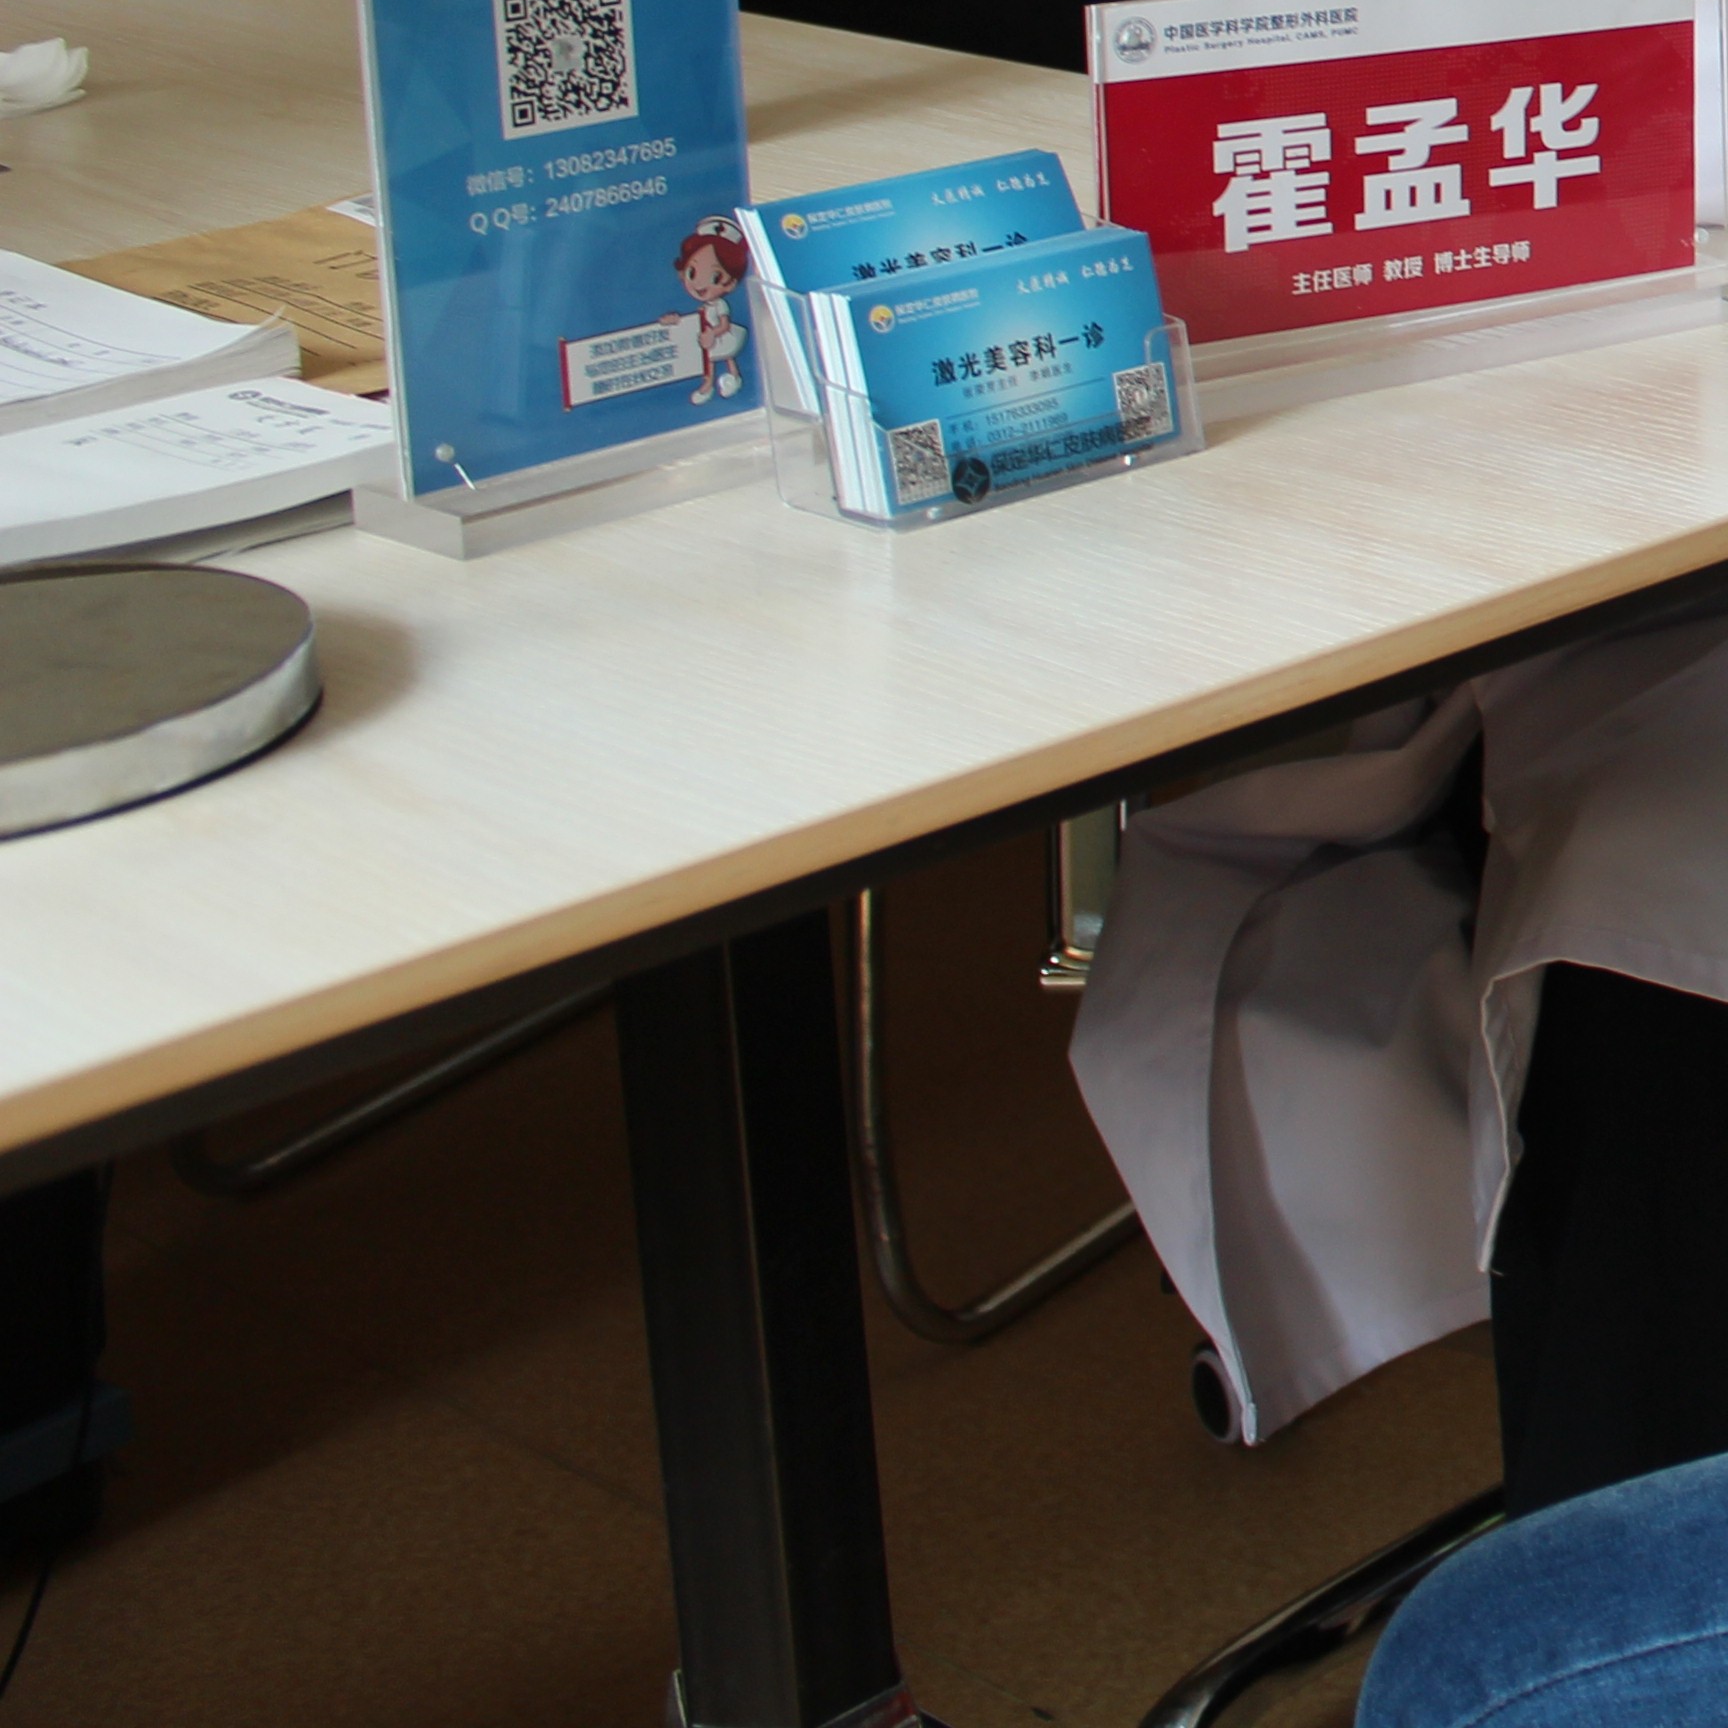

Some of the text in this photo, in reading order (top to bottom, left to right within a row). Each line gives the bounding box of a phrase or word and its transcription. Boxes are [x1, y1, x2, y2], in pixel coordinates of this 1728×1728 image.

[1163, 7, 1359, 41] 中国医学科学院整形外科医院
[1212, 82, 1601, 254] 霍孟华
[1292, 240, 1531, 295] 主任医师 教授 博士生导师
[931, 321, 1105, 388] 激光美容科一诊
